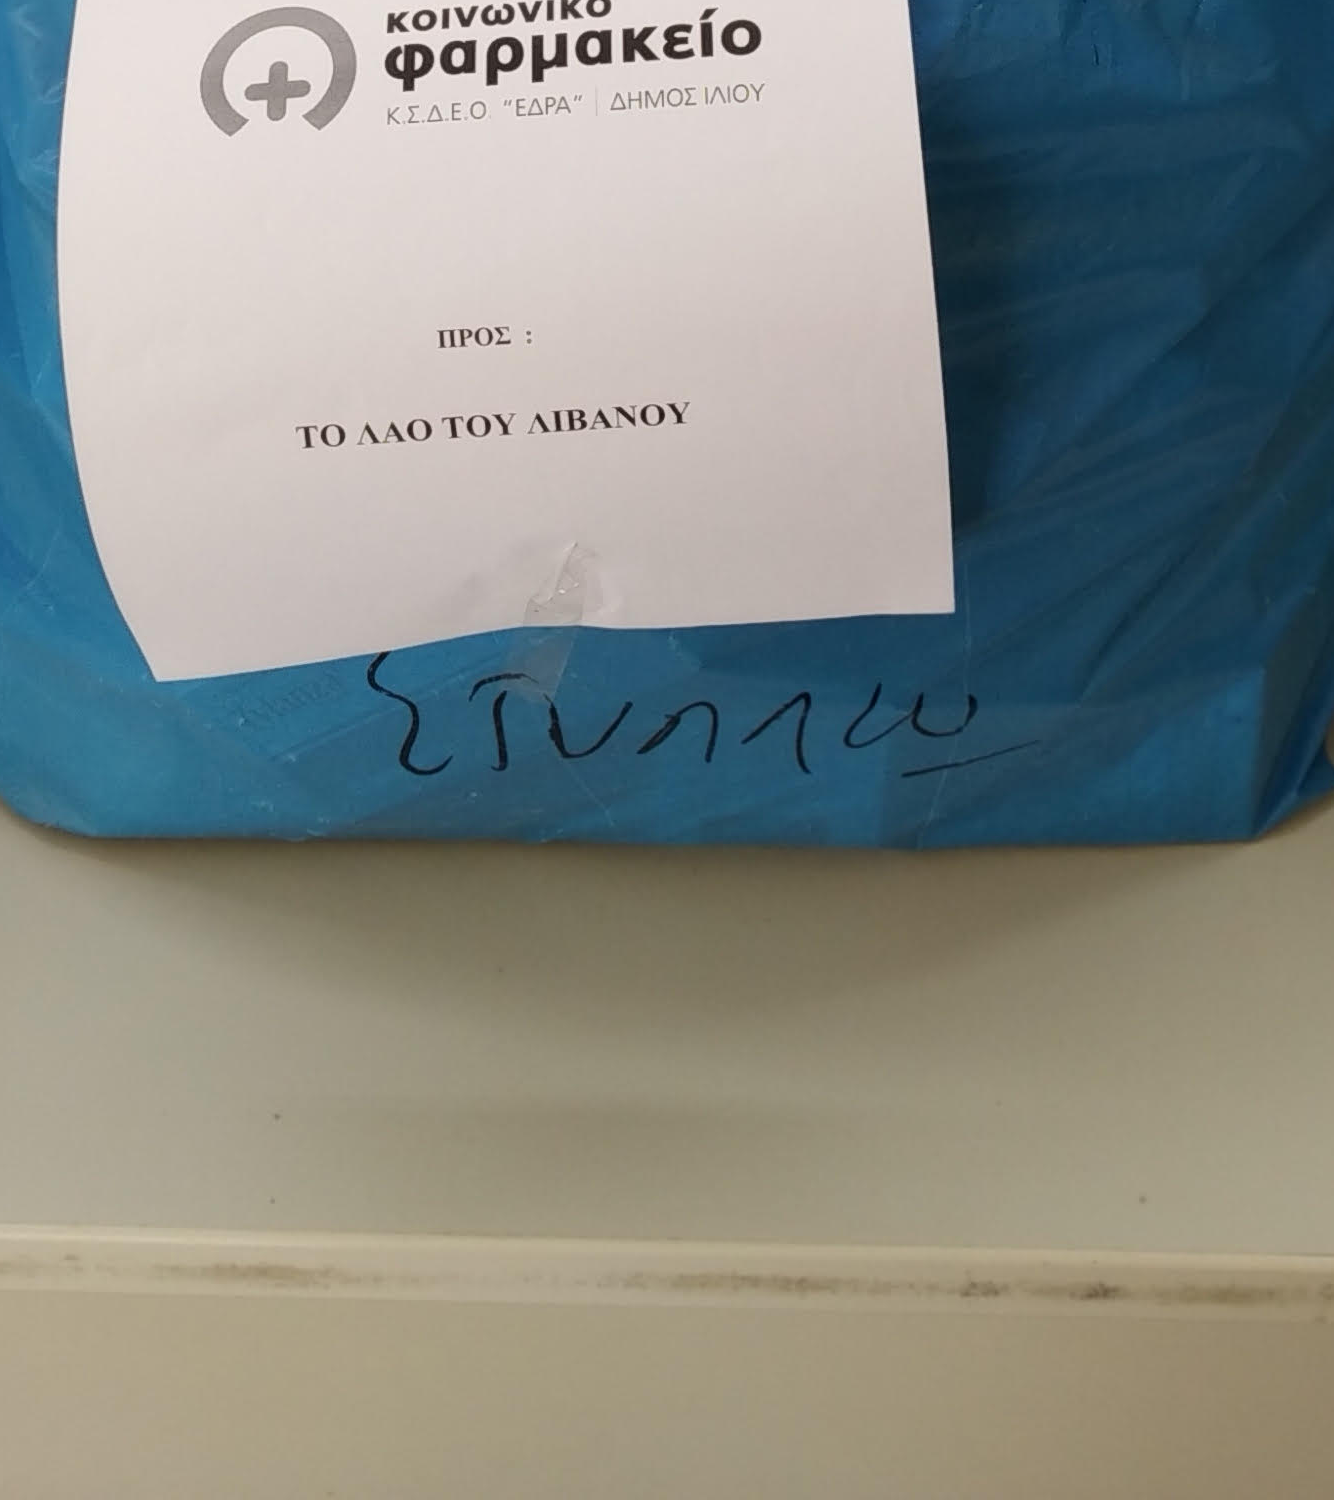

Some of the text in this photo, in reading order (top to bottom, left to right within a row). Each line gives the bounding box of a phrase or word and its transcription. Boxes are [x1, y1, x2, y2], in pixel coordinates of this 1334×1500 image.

[384, 7, 763, 92] φαρμακείο
[610, 86, 698, 111] ΔΗΜΟΣ
[704, 83, 765, 105] ΙΛΙΟΥ
[436, 326, 512, 349] ΠΡΟΣ
[295, 401, 691, 449] ΤΟ ΛΑΟ ΤΟΥ ΛΙΒΑΝΟΥ
